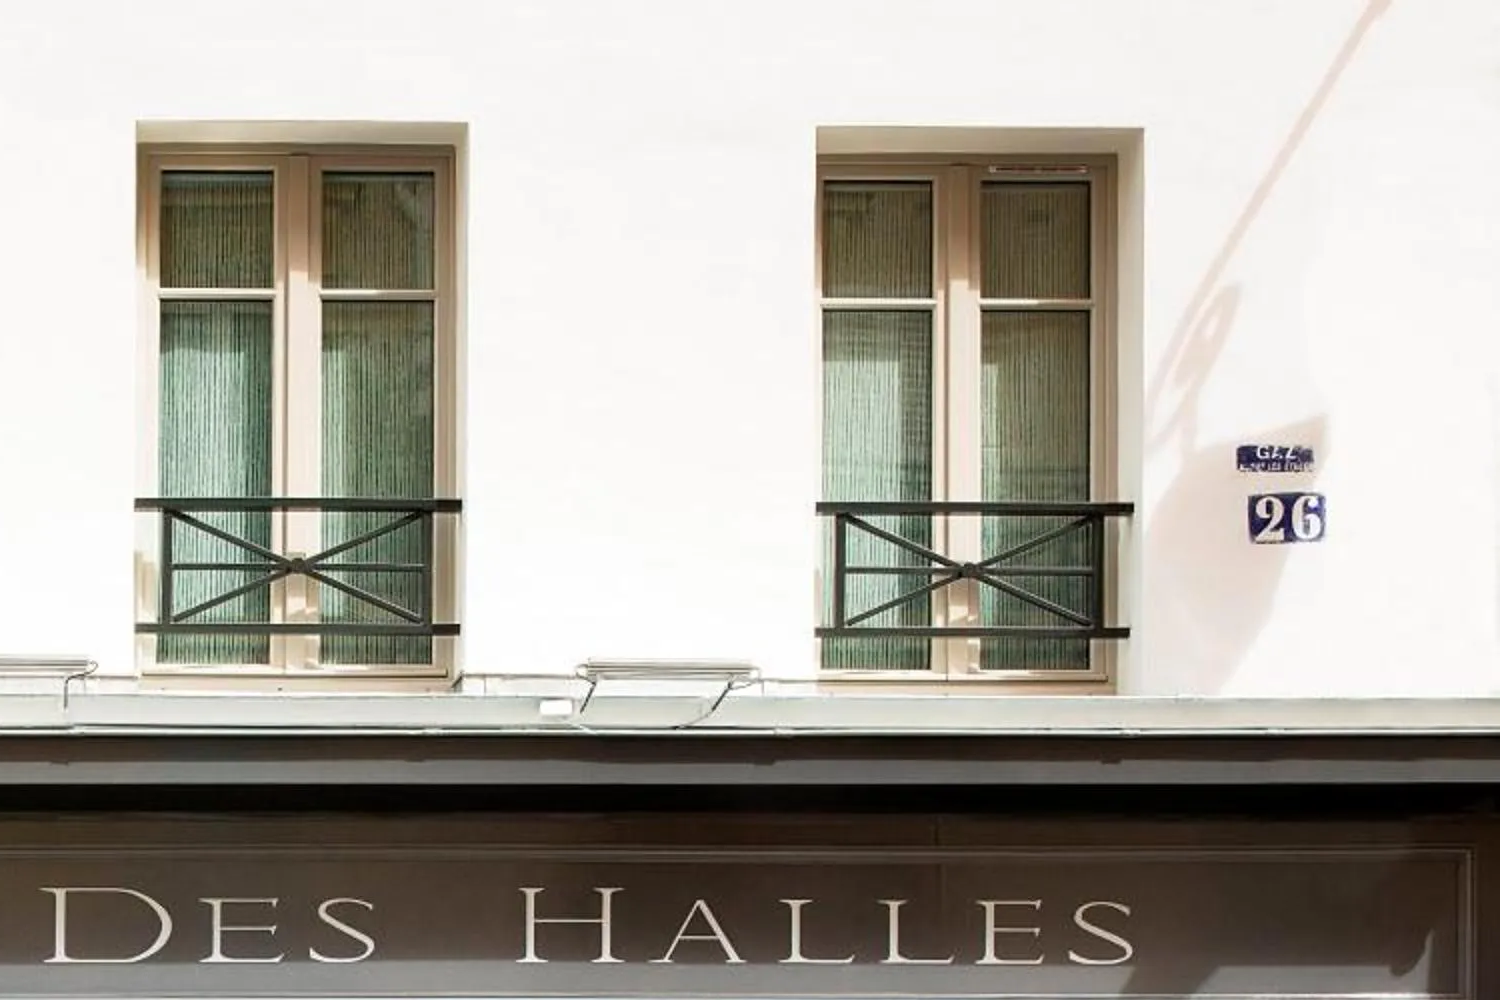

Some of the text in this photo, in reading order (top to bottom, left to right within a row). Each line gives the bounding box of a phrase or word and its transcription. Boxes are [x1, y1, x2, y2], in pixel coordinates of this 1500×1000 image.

[1254, 494, 1321, 542] 26
[41, 887, 377, 964] DES
[516, 887, 1135, 966] HALLES
